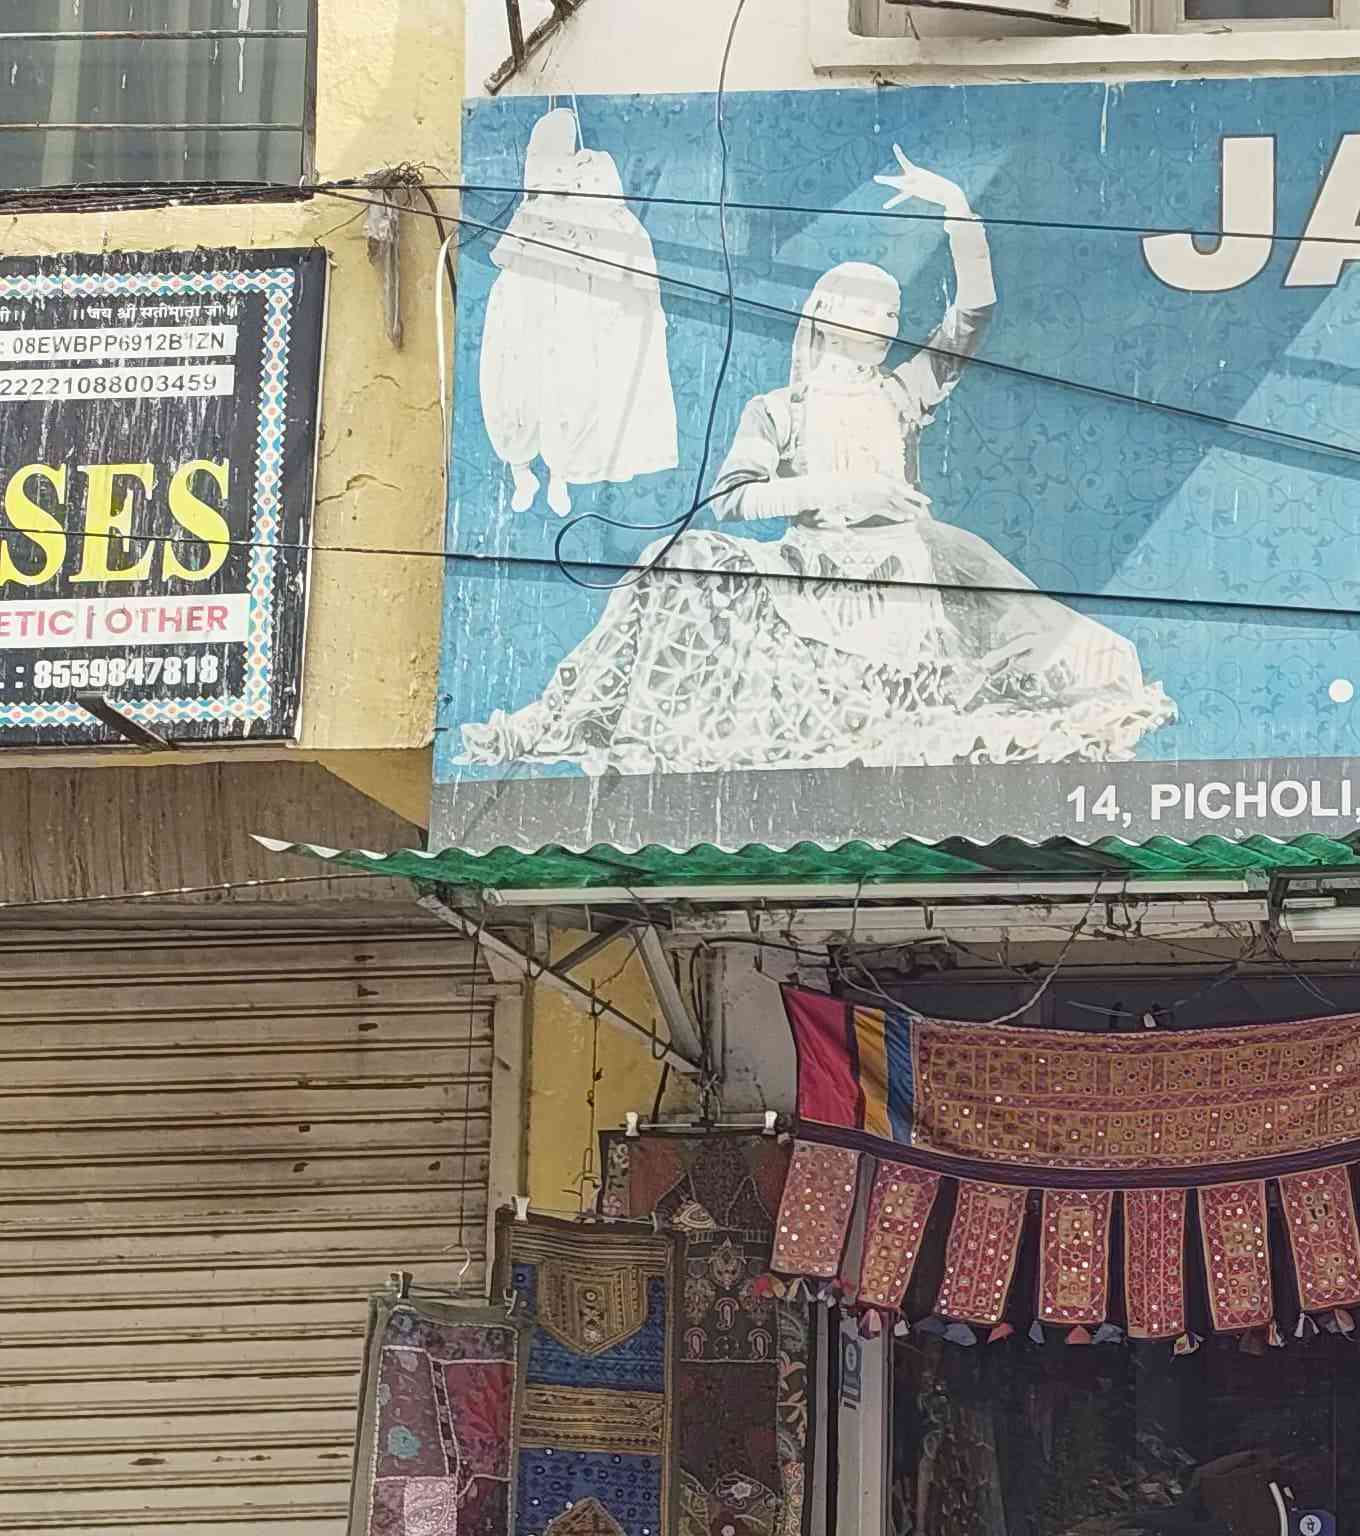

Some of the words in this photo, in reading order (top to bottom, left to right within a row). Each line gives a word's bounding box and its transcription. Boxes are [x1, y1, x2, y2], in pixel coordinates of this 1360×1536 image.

[0, 374, 217, 394] 22221088003459
[0, 458, 231, 586] SES
[105, 605, 229, 637] OTHER
[33, 655, 219, 690] 8559847818
[1066, 785, 1132, 827] 14,
